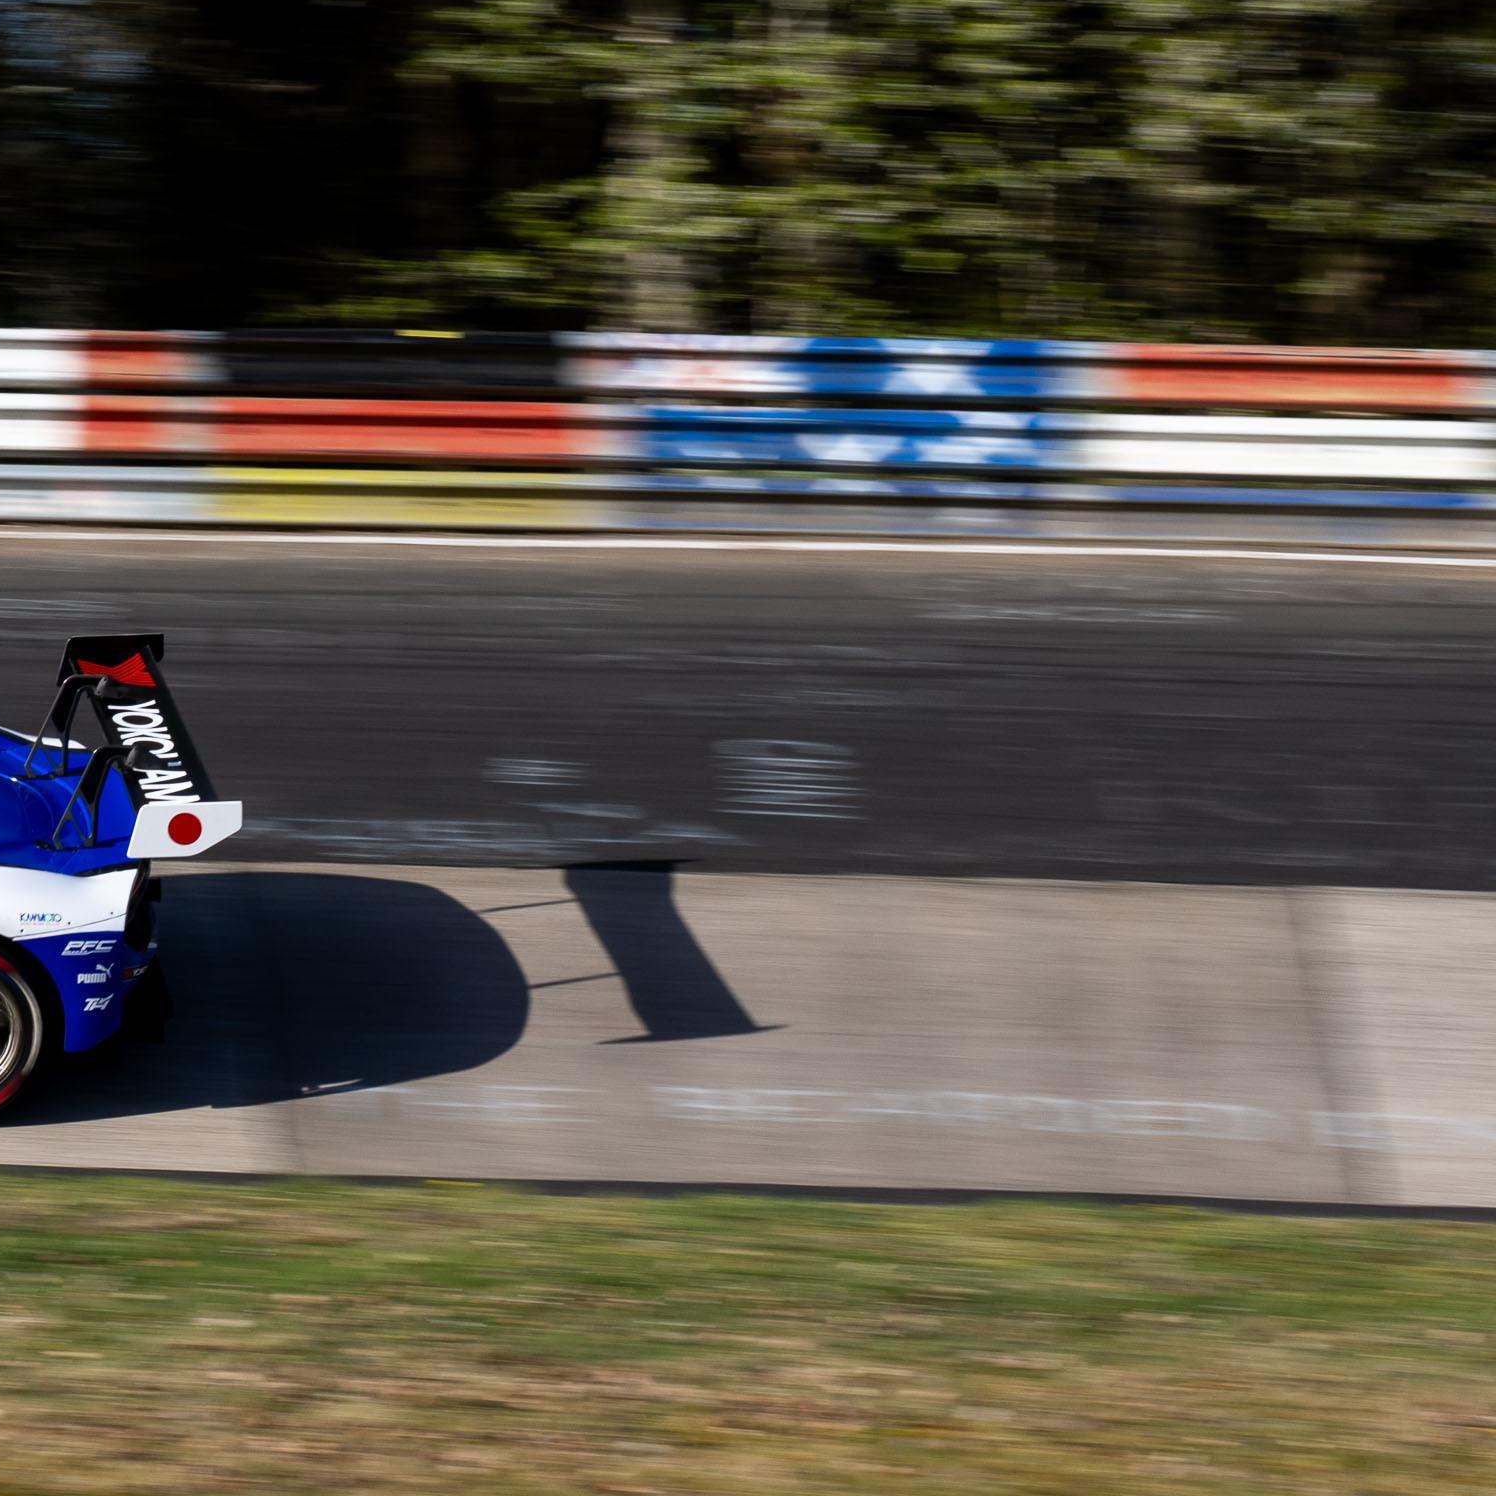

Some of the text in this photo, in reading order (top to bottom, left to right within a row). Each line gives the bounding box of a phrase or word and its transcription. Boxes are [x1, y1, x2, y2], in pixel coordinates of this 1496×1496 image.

[108, 699, 201, 805] YOKOAM
[61, 940, 117, 956] PFC
[77, 973, 107, 984] PUMA
